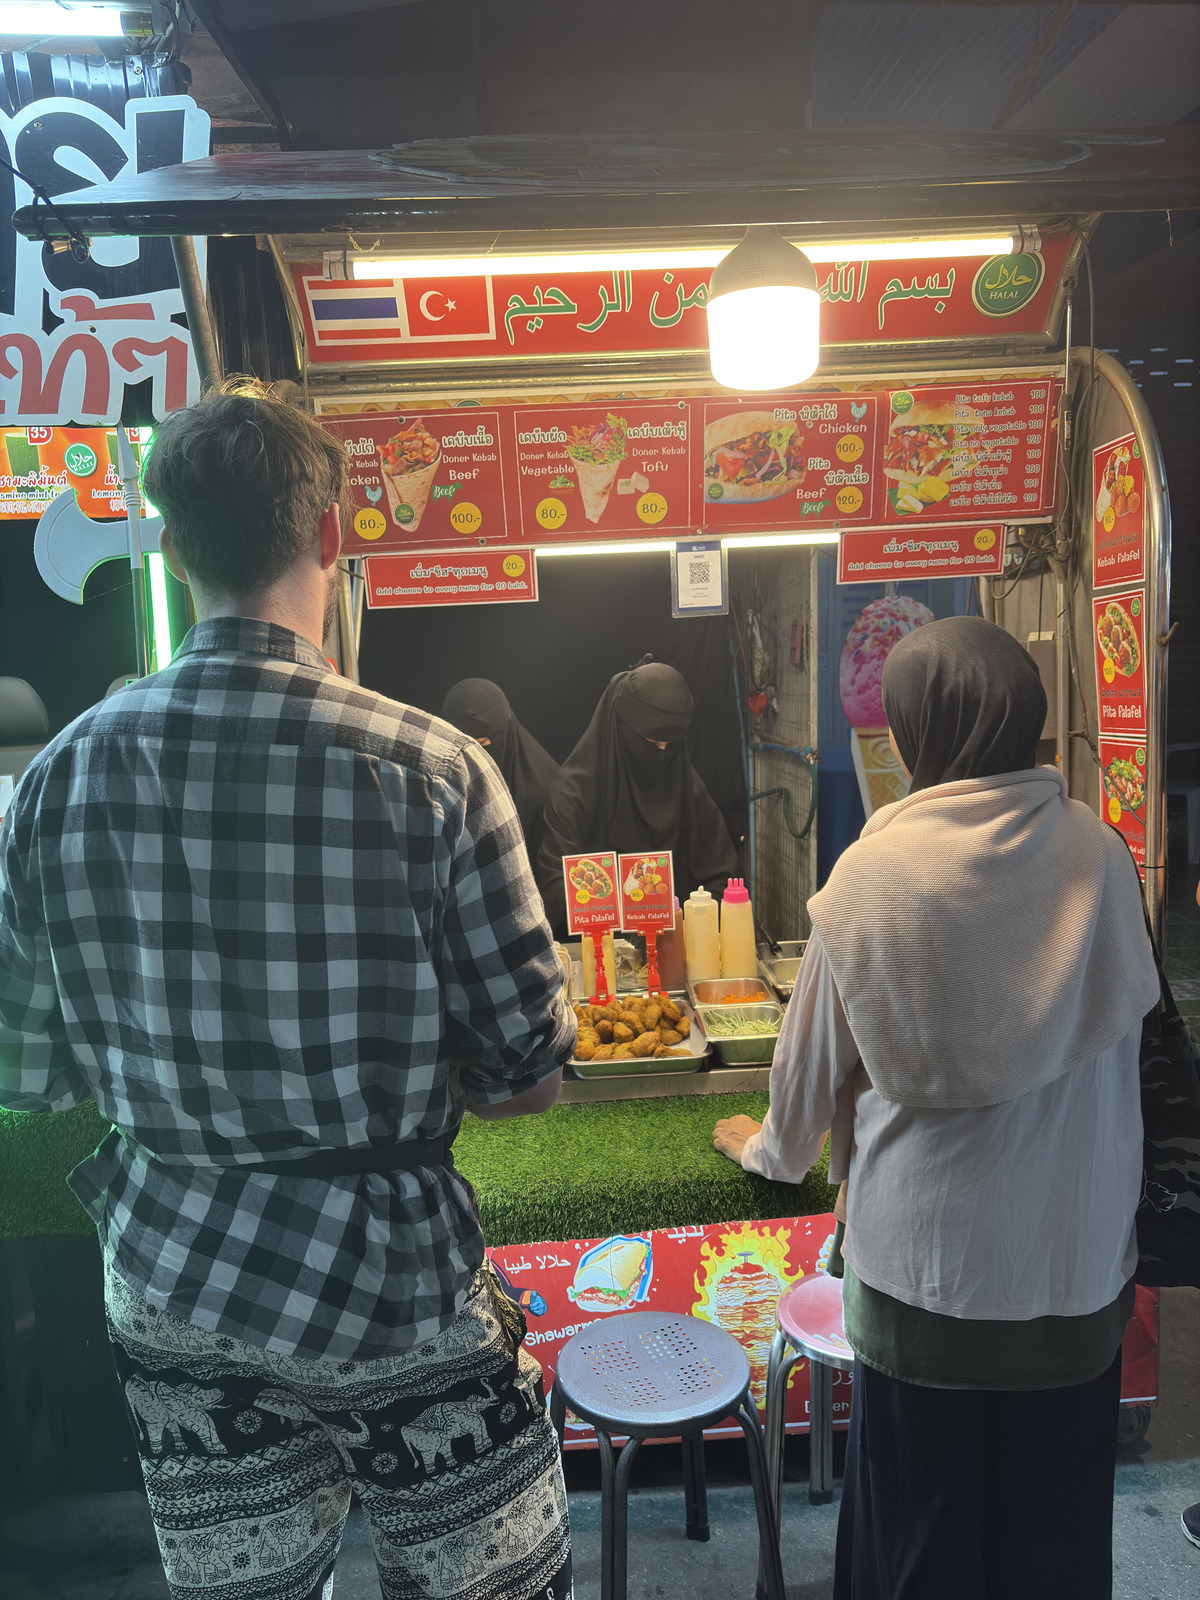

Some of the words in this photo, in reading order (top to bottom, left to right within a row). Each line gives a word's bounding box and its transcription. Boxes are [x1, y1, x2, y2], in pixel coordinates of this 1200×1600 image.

[985, 263, 1033, 290] حلال
[878, 268, 955, 329] بسم
[989, 290, 1020, 300] HALAL
[504, 270, 632, 346] الرحيم
[955, 394, 971, 404] Pita
[973, 393, 991, 403] tofu
[992, 391, 1014, 401] kebab
[1030, 389, 1046, 400] 100
[774, 408, 796, 421] Pita
[954, 409, 970, 419] Pita
[974, 409, 992, 417] tuna
[994, 406, 1016, 417] kebab
[1029, 404, 1044, 414] 100
[131, 426, 140, 437] 3
[819, 423, 867, 434] Chicken
[953, 424, 969, 433] Pita
[971, 423, 988, 434] only
[989, 420, 1027, 433] vegetable
[1028, 419, 1043, 430] 100
[30, 426, 48, 439] 35
[952, 438, 968, 448] Pita
[970, 440, 980, 448] no
[982, 436, 1019, 448] vegetable
[1026, 434, 1042, 445] 120
[632, 447, 659, 456] Doner
[662, 446, 686, 454] Kebab
[837, 443, 863, 453] 100.-
[443, 454, 470, 464] Doner
[472, 453, 497, 462] Kebab
[520, 452, 545, 461] Doner
[547, 450, 569, 459] Kebab
[1026, 449, 1042, 459] 100
[356, 460, 379, 469] Kebab
[641, 461, 669, 473] Tofu
[808, 457, 830, 470] Pita
[1025, 464, 1040, 474] 100
[449, 468, 480, 480] Beef
[521, 464, 575, 477] Vegetable
[347, 475, 380, 486] icken
[1024, 478, 1039, 488] 100
[0, 490, 27, 499] smine
[28, 488, 48, 499] mint
[50, 488, 61, 498] te
[796, 488, 827, 499] Beef
[1023, 493, 1038, 502] 120
[836, 495, 861, 505] 120.-
[541, 508, 566, 519] 80.-
[642, 503, 666, 514] 80.-
[360, 518, 385, 530] 80.-
[452, 513, 481, 524] 100.-
[848, 562, 864, 571] Add
[865, 560, 893, 570] cheese
[894, 560, 903, 568] to
[905, 560, 927, 568] every
[928, 558, 948, 567] menu
[950, 556, 964, 566] for
[965, 556, 975, 564] 20
[976, 554, 996, 563] baht.
[1097, 554, 1116, 568] Kebab
[1117, 548, 1140, 564] falafel
[376, 586, 392, 596] Add
[394, 586, 422, 594] cheese
[424, 584, 433, 594] to
[435, 584, 458, 594] every
[459, 584, 479, 592] menu
[480, 582, 494, 592] for
[496, 581, 506, 590] 20
[508, 580, 528, 590] baht.
[1102, 705, 1117, 718] Pita
[1118, 705, 1142, 719] falafel
[574, 915, 590, 924] Pita
[591, 912, 615, 922] falafel
[648, 912, 670, 920] falafel
